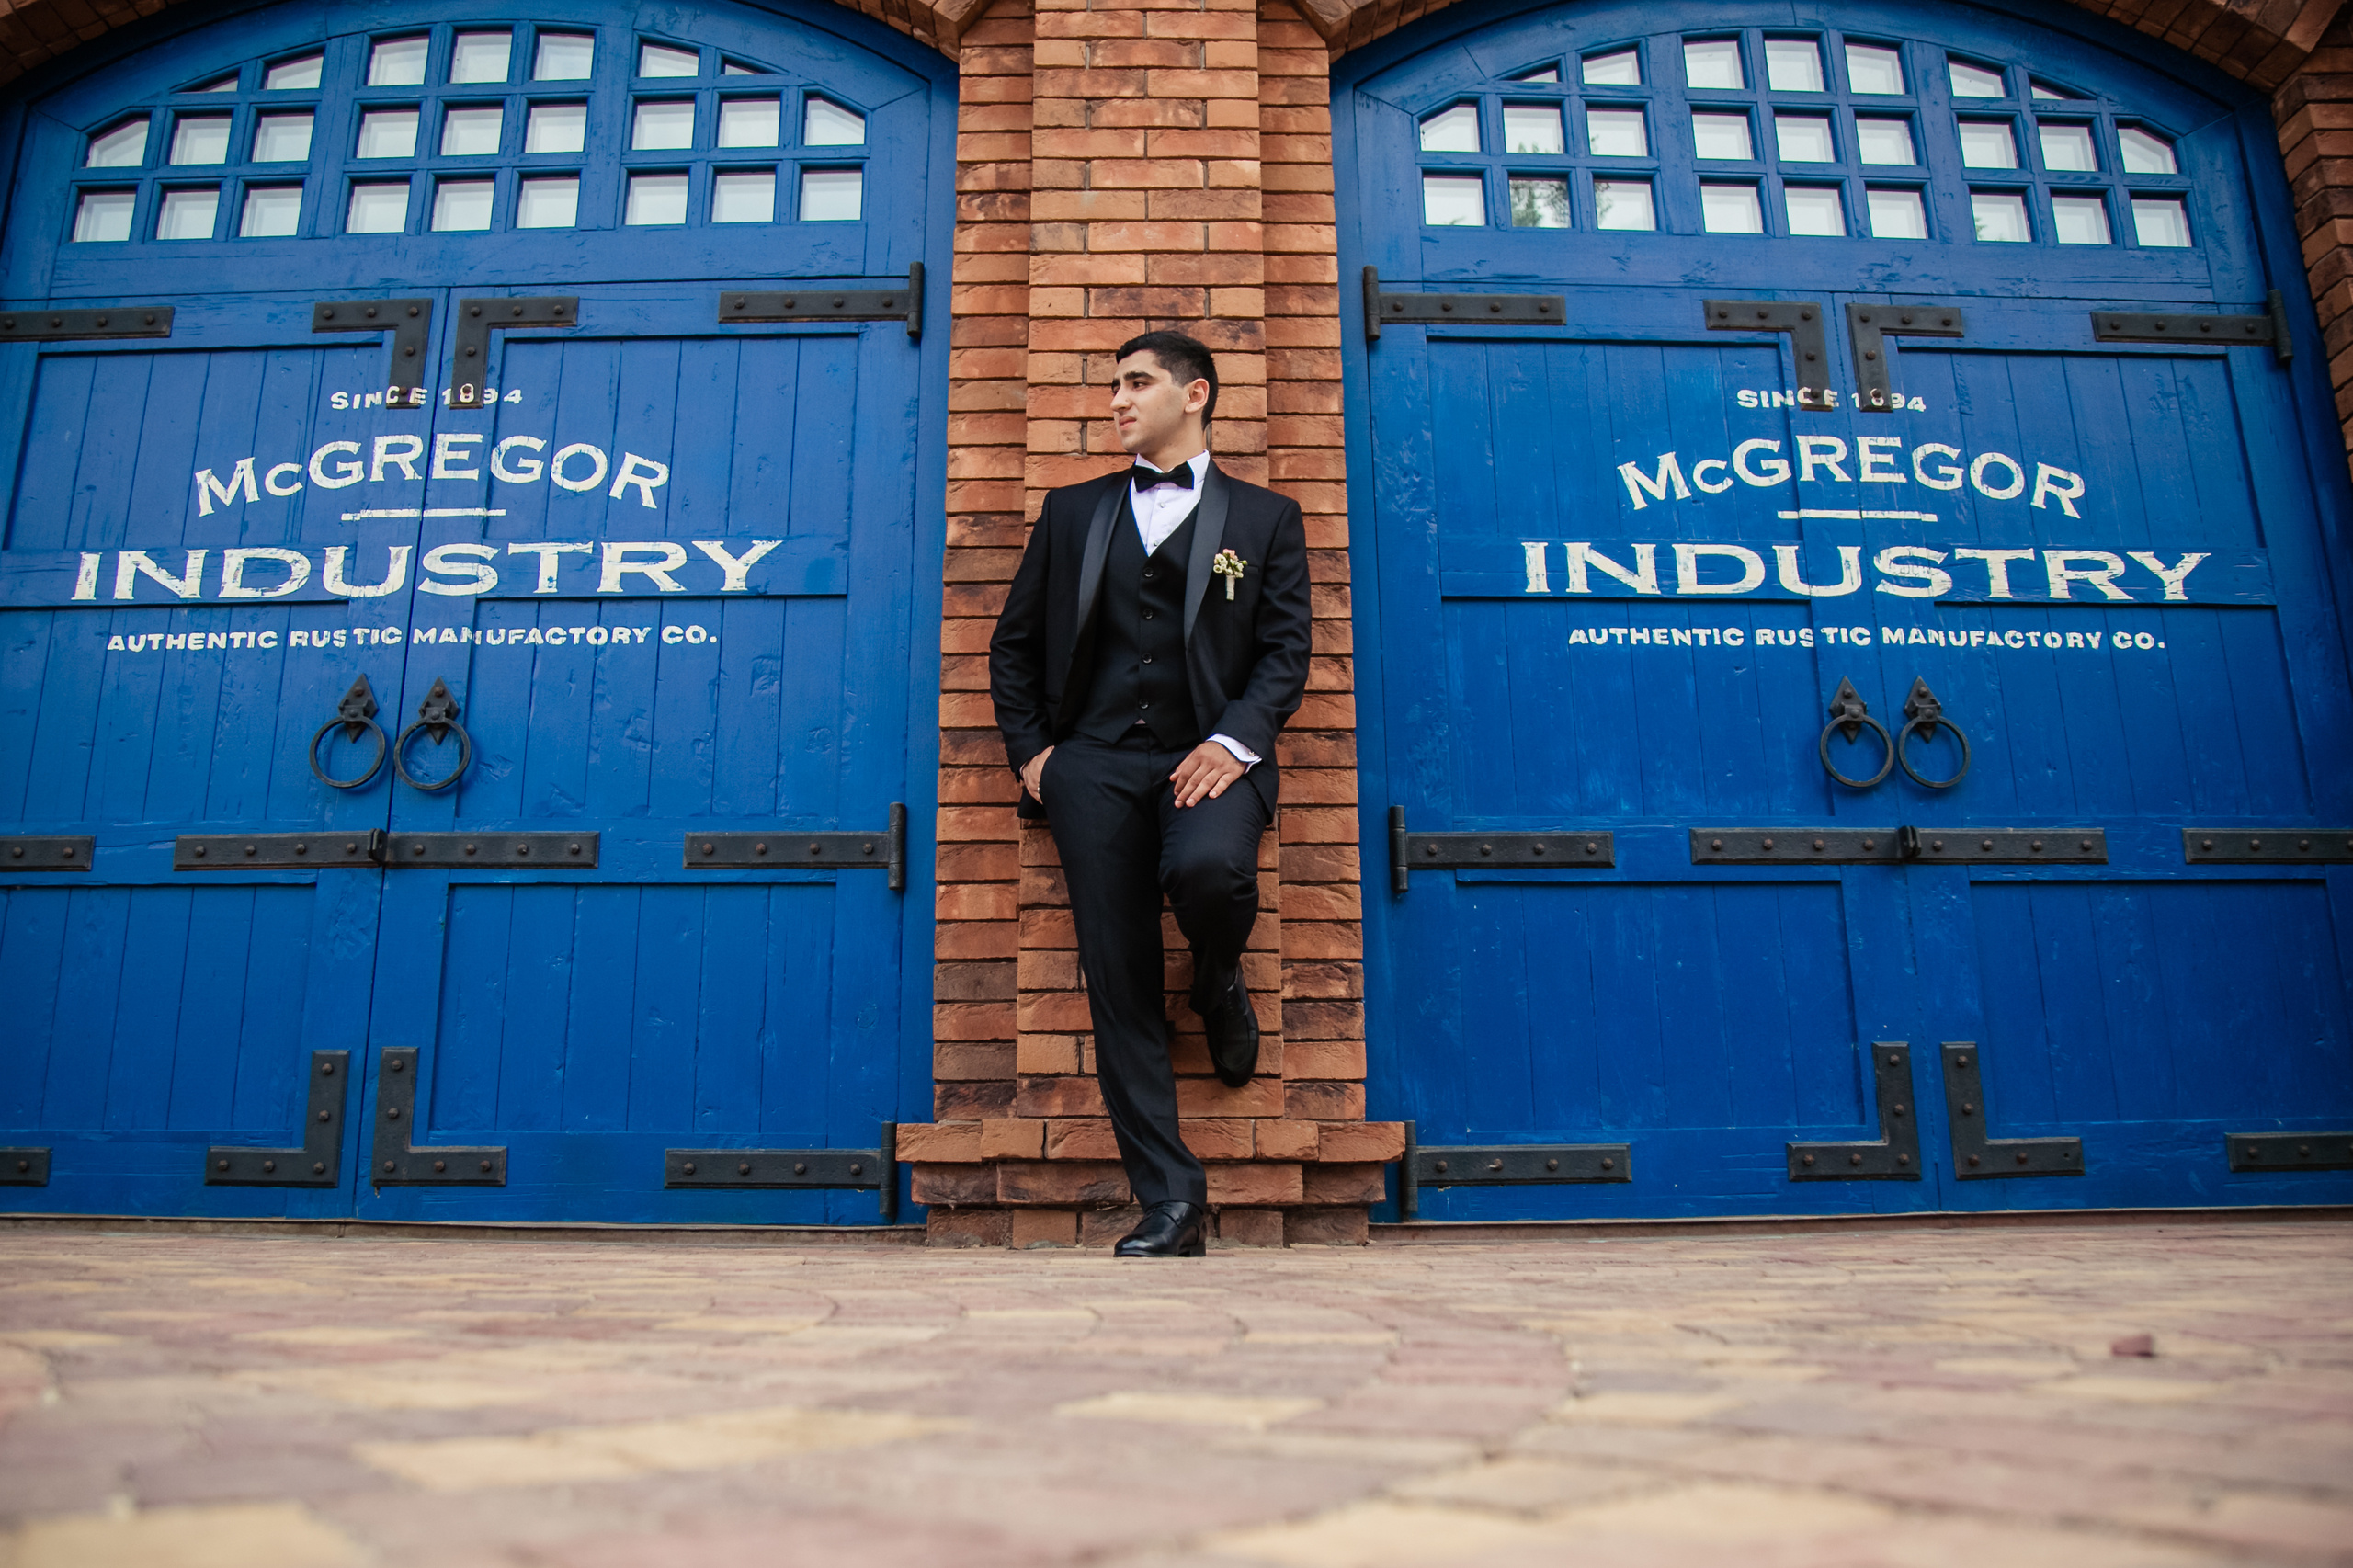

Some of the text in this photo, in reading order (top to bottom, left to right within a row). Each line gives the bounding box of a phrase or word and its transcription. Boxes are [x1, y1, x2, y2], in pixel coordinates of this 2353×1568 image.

[330, 382, 523, 410] SINCE 1894
[1736, 386, 1927, 413] SINCE 1894
[194, 433, 669, 517] McGREGOR
[1618, 435, 2086, 520] McGREGOR
[72, 540, 783, 600] INDUSTRY
[1521, 541, 2211, 601] INDUSTRY
[107, 624, 719, 652] AUTHENTIC RUSTIC MANUFACTORY CO.
[1568, 626, 2166, 650] AUTHENTIC RUSTIC MANUFACTORY CO.
